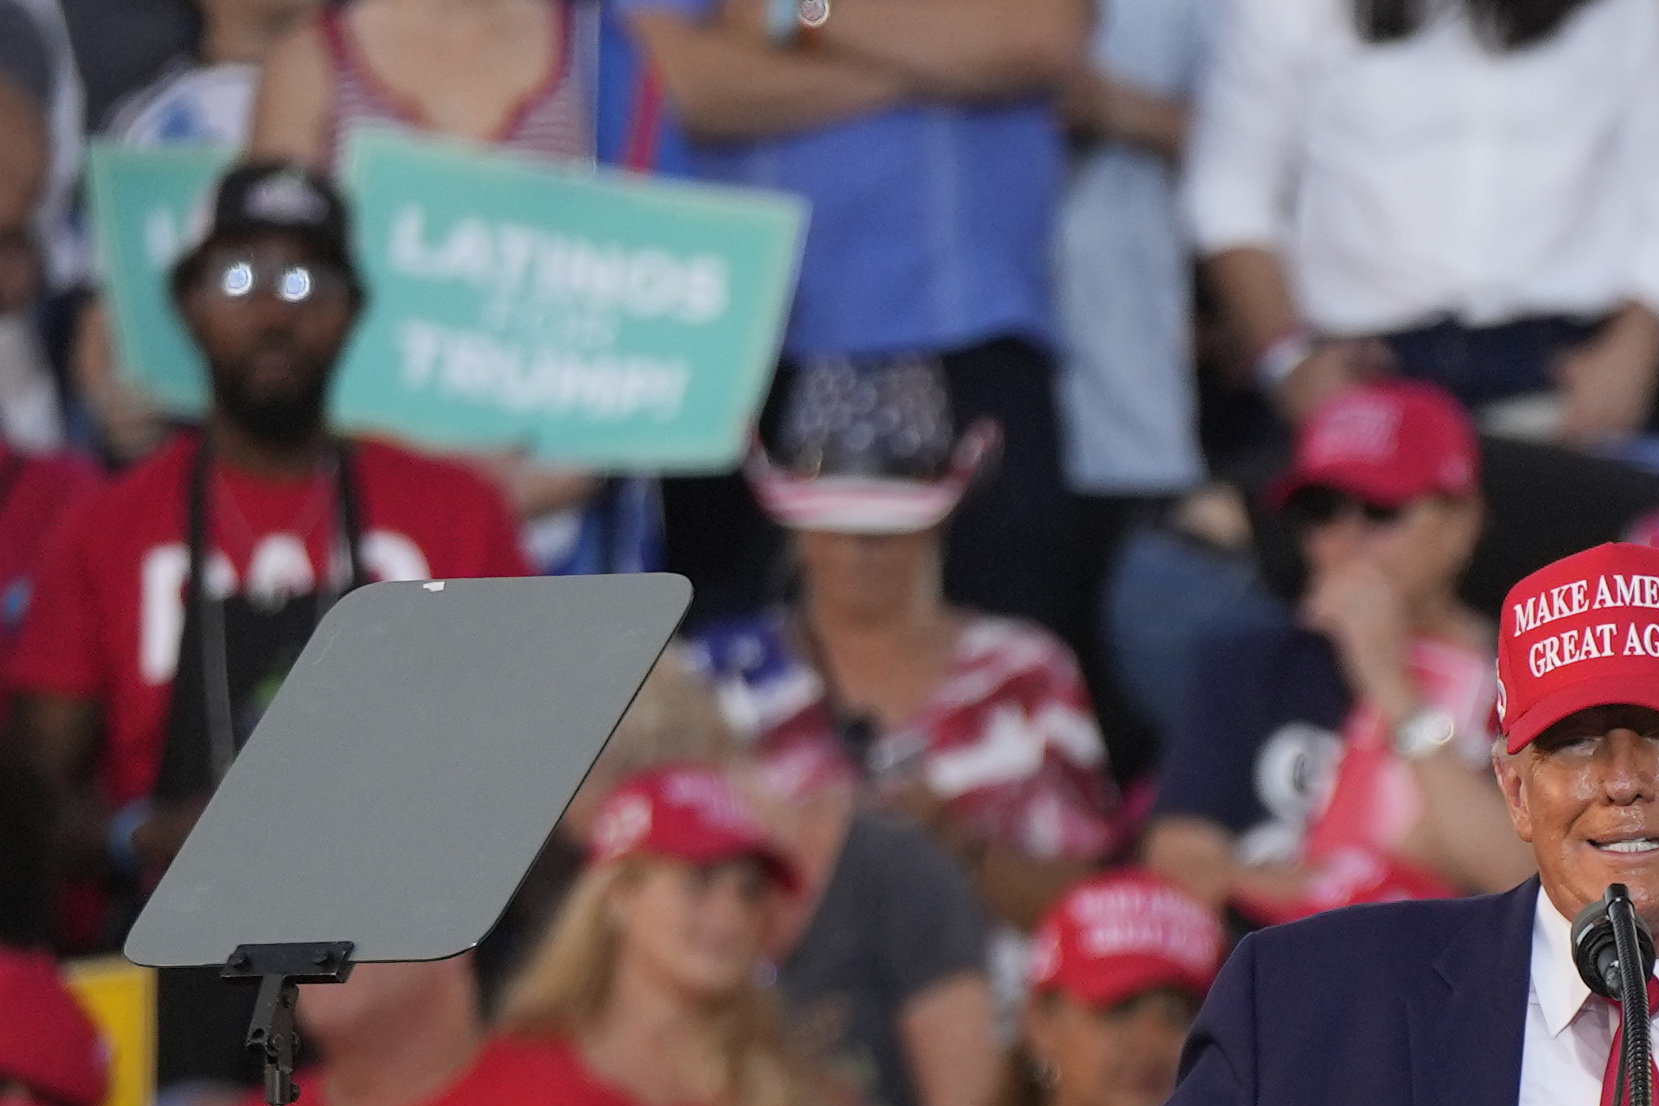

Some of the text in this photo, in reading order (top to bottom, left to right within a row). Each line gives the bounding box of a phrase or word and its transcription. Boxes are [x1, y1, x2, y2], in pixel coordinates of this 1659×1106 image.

[385, 203, 732, 325] LATINOS
[1513, 579, 1590, 638] MAKE
[1528, 623, 1618, 679] GREAT
